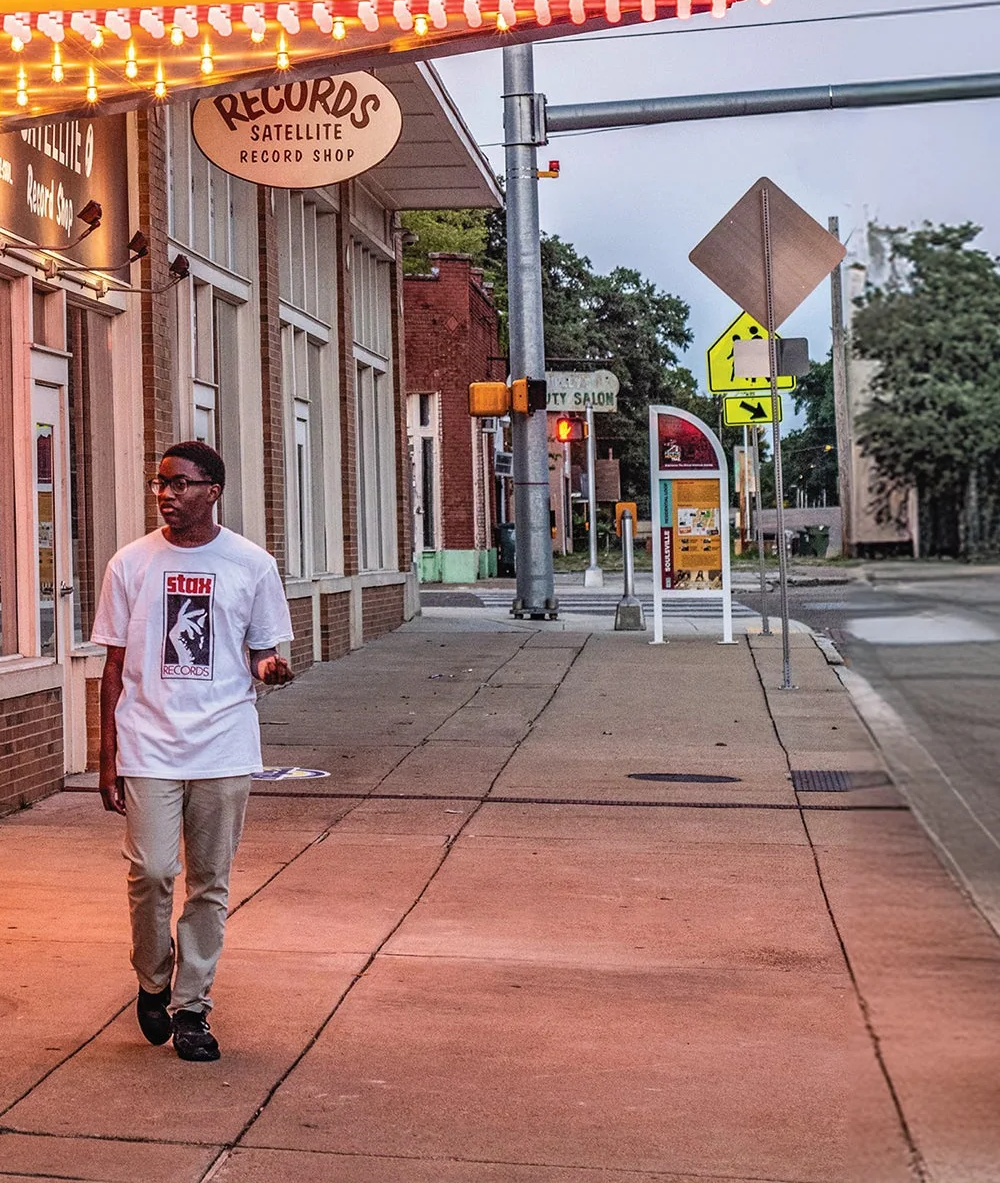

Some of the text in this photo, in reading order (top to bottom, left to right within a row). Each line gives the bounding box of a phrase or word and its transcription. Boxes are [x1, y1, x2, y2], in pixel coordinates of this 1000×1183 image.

[213, 75, 380, 131] RECORDS
[250, 123, 342, 142] SATELLITE
[239, 148, 355, 164] RECORD SHOP
[26, 163, 55, 221] Record
[55, 181, 74, 238] Shop
[574, 390, 614, 407] SALON
[167, 574, 212, 594] stax
[163, 665, 210, 677] RECORDS
